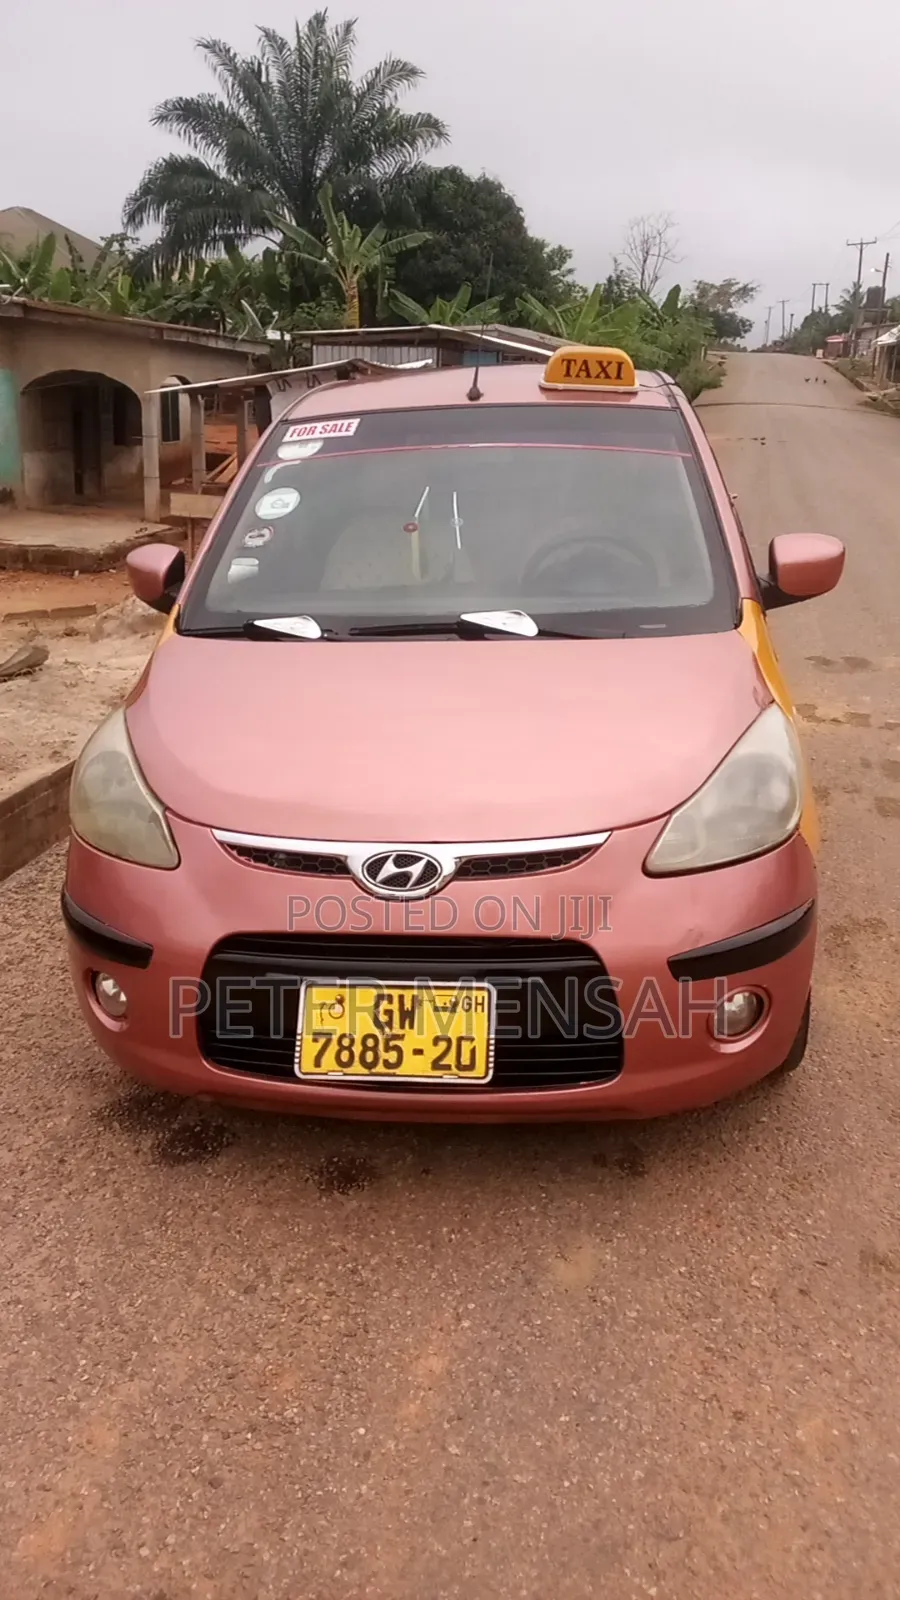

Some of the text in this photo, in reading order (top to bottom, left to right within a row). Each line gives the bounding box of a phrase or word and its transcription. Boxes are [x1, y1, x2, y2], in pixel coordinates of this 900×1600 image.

[561, 358, 624, 380] TAXI
[289, 421, 354, 438] FOR SALE
[373, 994, 416, 1031] GW
[461, 996, 485, 1013] GH
